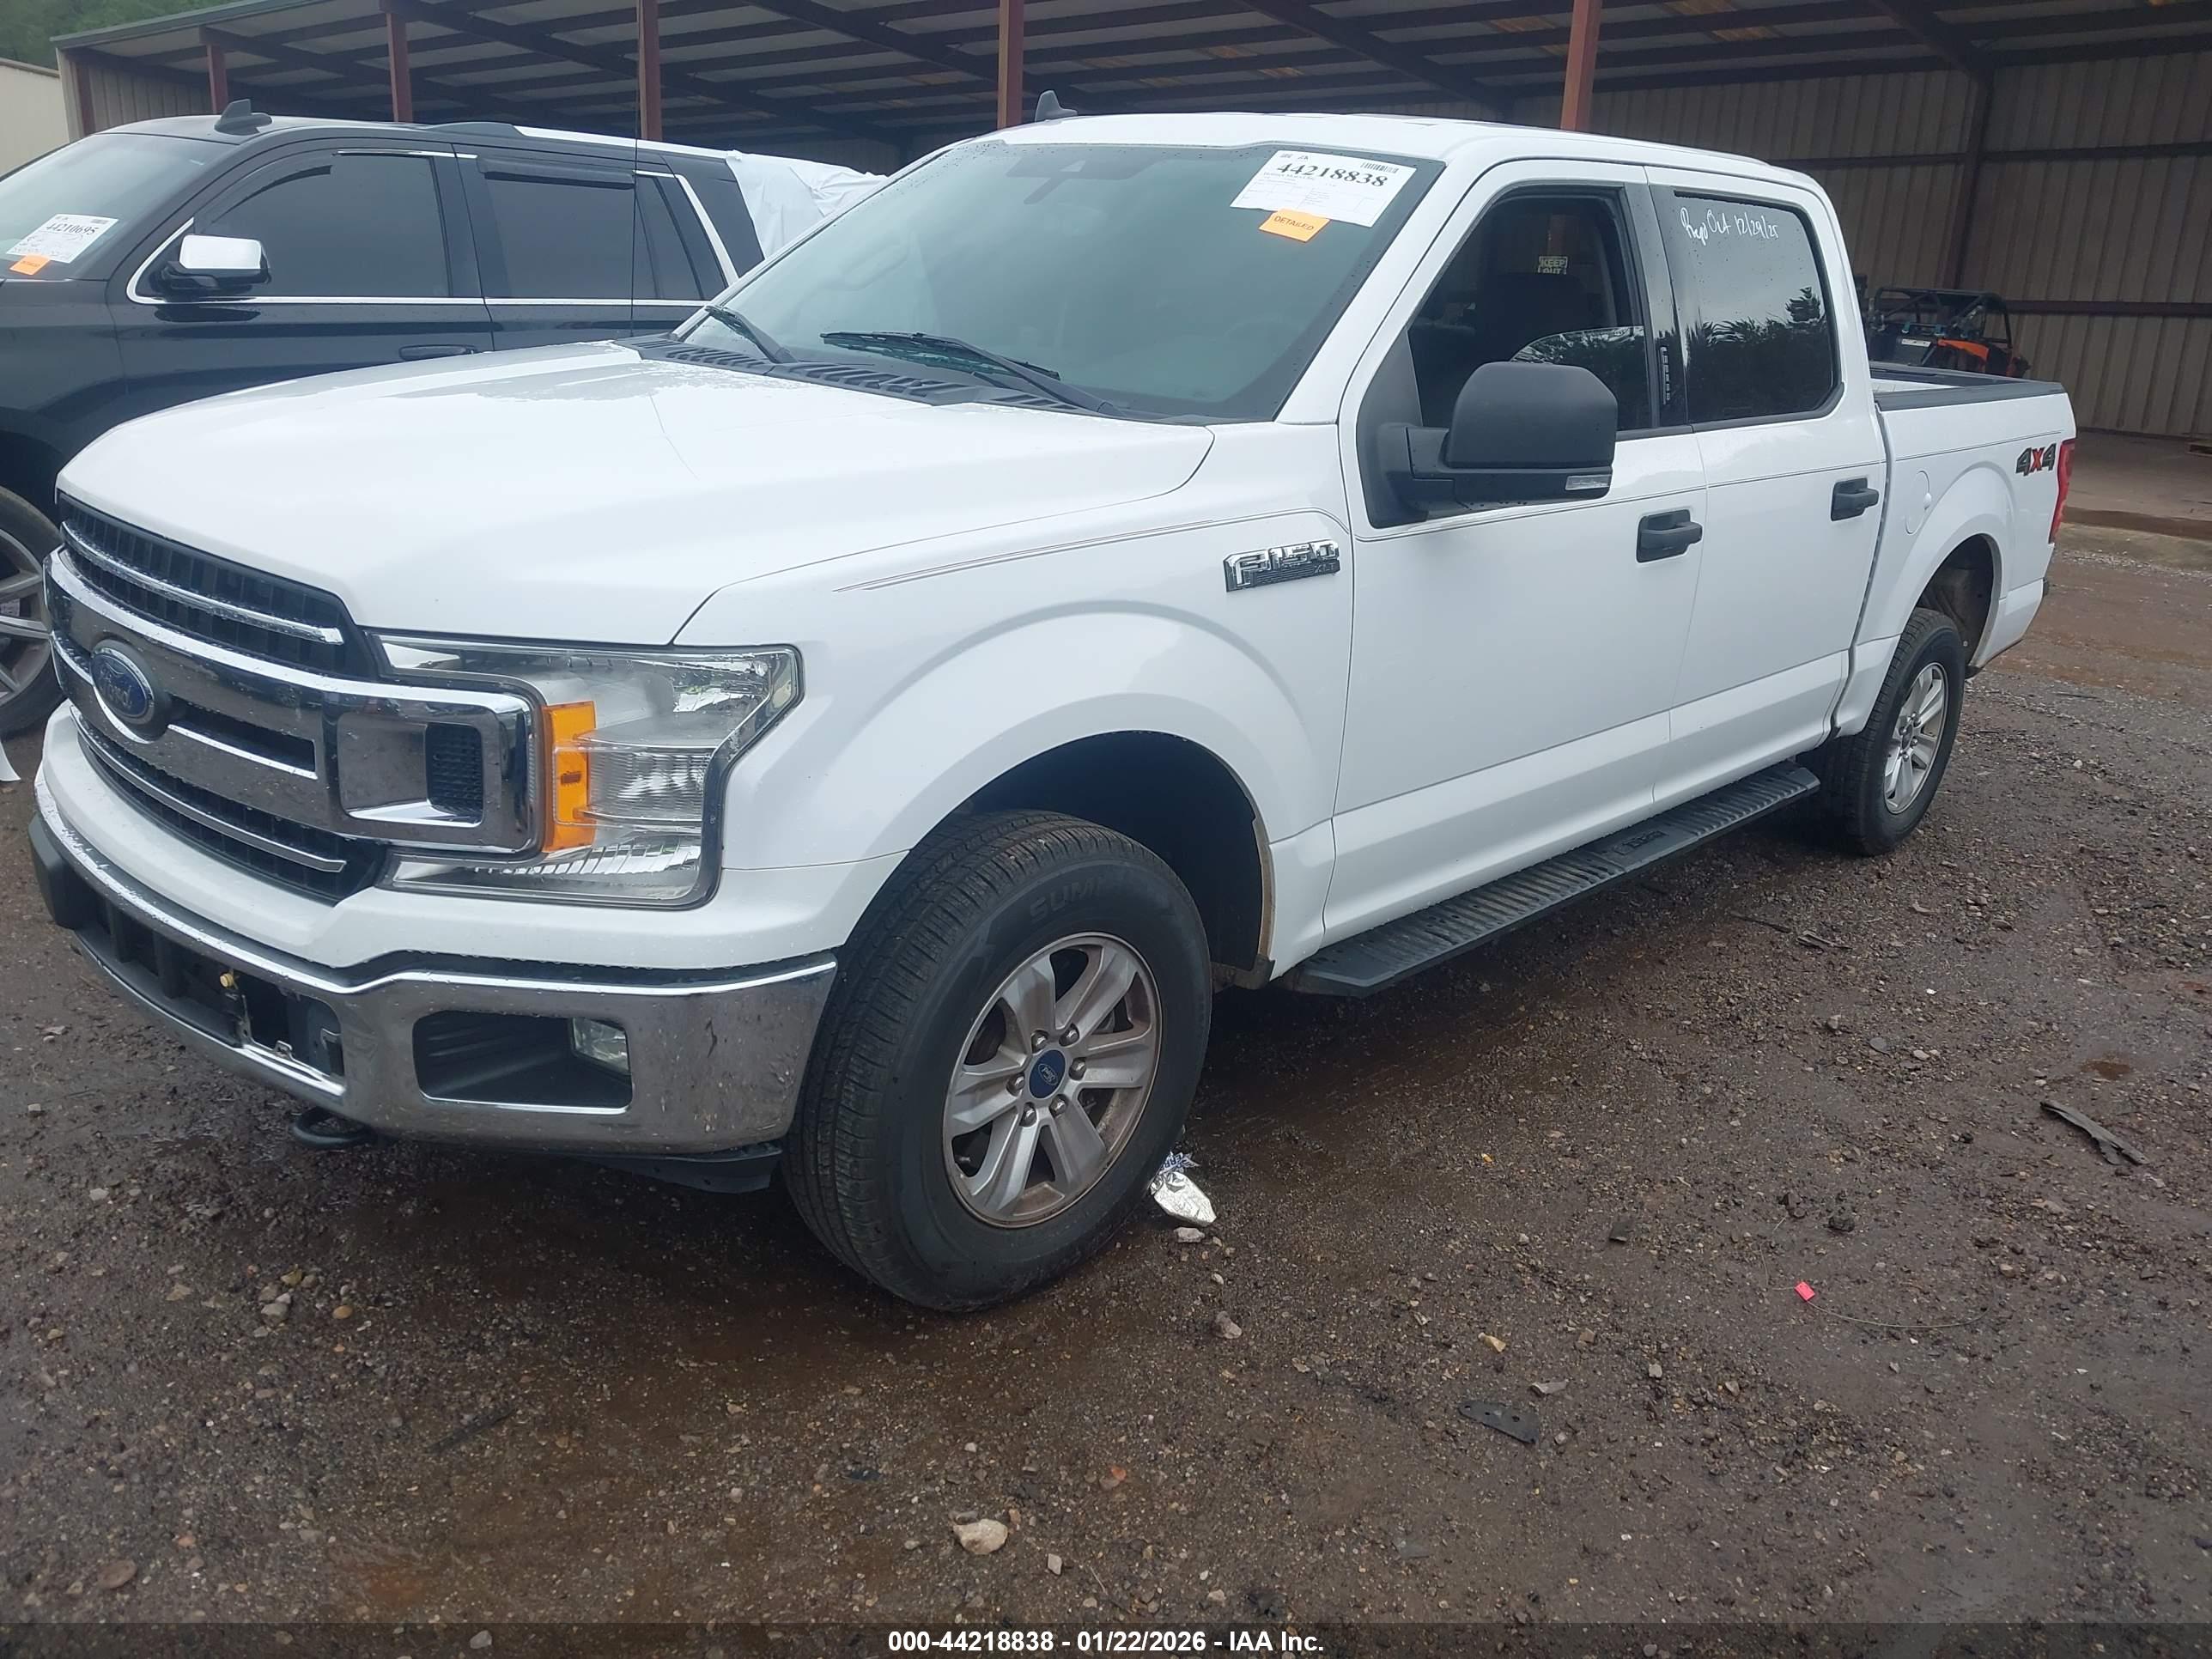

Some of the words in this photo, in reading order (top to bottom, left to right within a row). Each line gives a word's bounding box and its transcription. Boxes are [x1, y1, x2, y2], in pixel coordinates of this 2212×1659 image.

[1277, 163, 1388, 187] 44218838
[1274, 216, 1314, 231] DETAILED
[1707, 210, 1731, 234] Out
